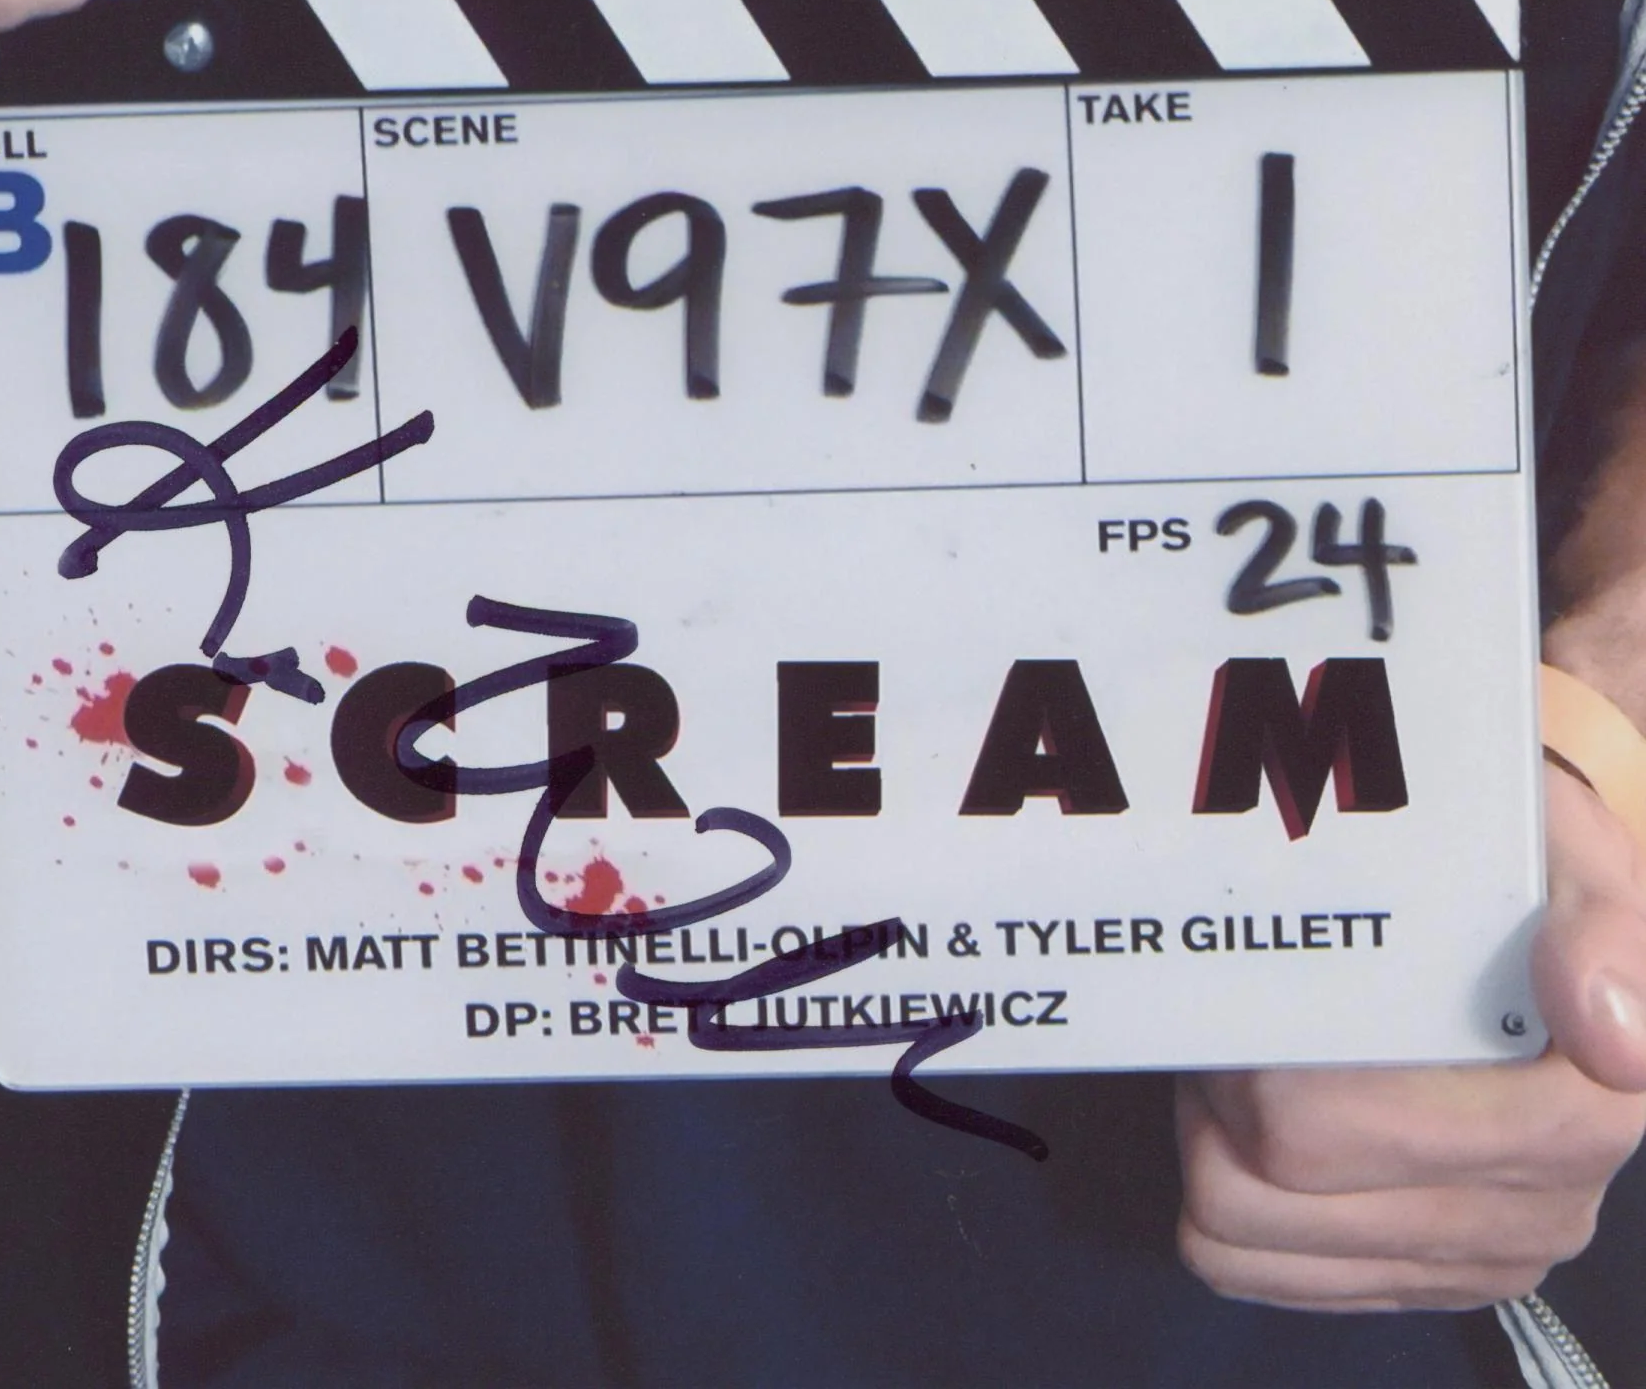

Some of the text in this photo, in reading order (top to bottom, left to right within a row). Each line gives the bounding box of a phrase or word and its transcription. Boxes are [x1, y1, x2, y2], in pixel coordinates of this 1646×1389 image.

[373, 114, 519, 148] SCENE
[1077, 92, 1192, 124] TAKE
[63, 194, 368, 420] 184
[447, 168, 1066, 423] V97X
[1097, 519, 1191, 553] FPS
[1216, 497, 1417, 642] 24
[117, 658, 1409, 841] SCREAM
[146, 913, 1391, 975] DIRS: MATT BETTINELLI-OLPIN & TYLER GILLETT
[465, 990, 1069, 1038] DP: BRETT JUTKIEWICZ
